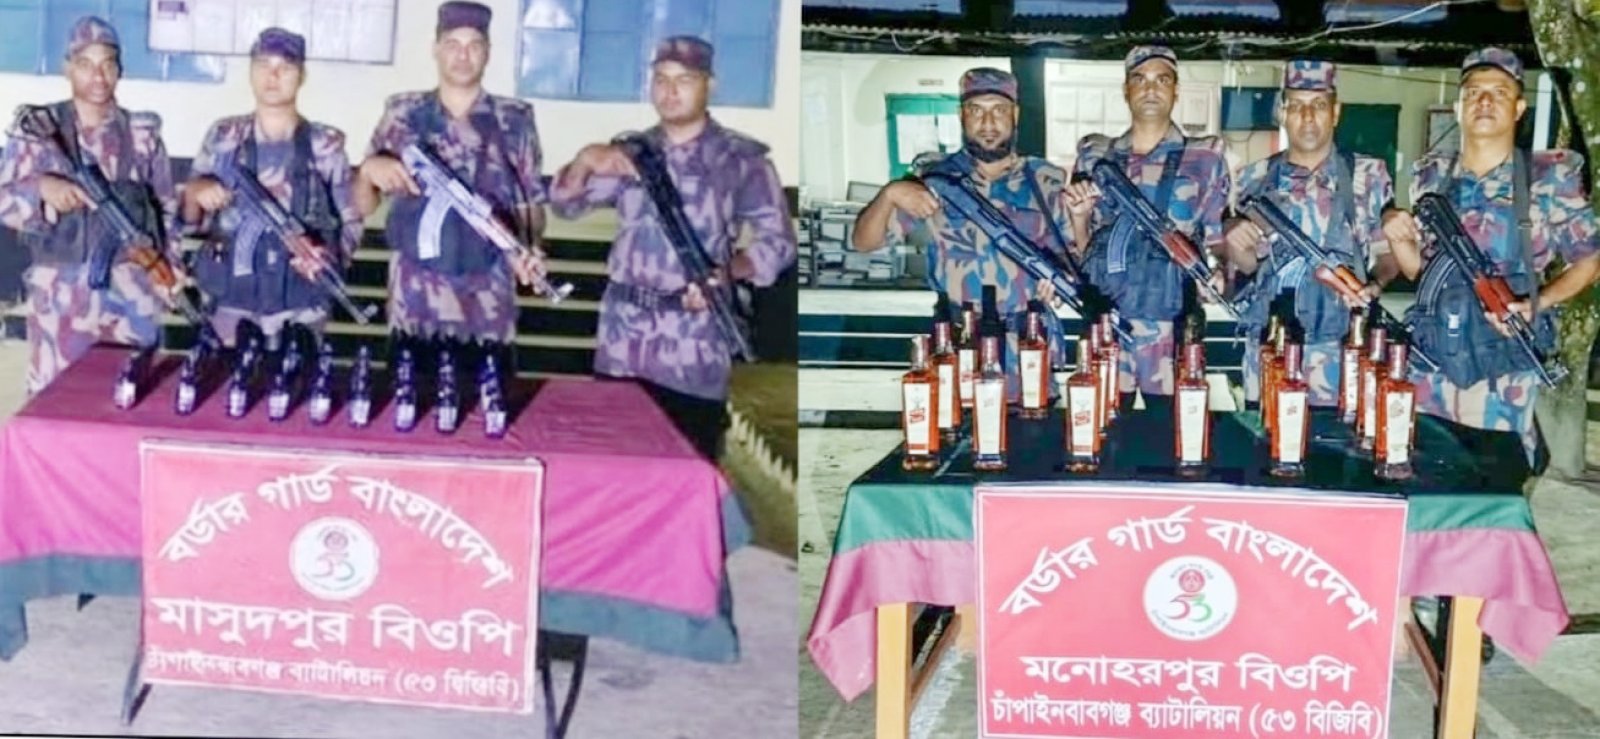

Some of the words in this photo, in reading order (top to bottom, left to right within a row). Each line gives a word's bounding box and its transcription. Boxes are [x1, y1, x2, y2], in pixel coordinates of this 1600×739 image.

[159, 493, 249, 562] বর্ডার
[258, 465, 340, 508] গার্ড
[348, 475, 513, 588] বাংলাদেশ
[999, 537, 1098, 615] বর্ডার
[1108, 505, 1195, 551] গার্ড
[1202, 517, 1377, 630] বাংলাদেশ
[151, 597, 354, 649] মাসুদপুর
[369, 605, 522, 656] বিওপি
[1019, 655, 1224, 694] মনোহরপুর
[1234, 652, 1357, 692] বিওপি
[990, 689, 1131, 727] চাঁপাইনবাবগঞ্জ
